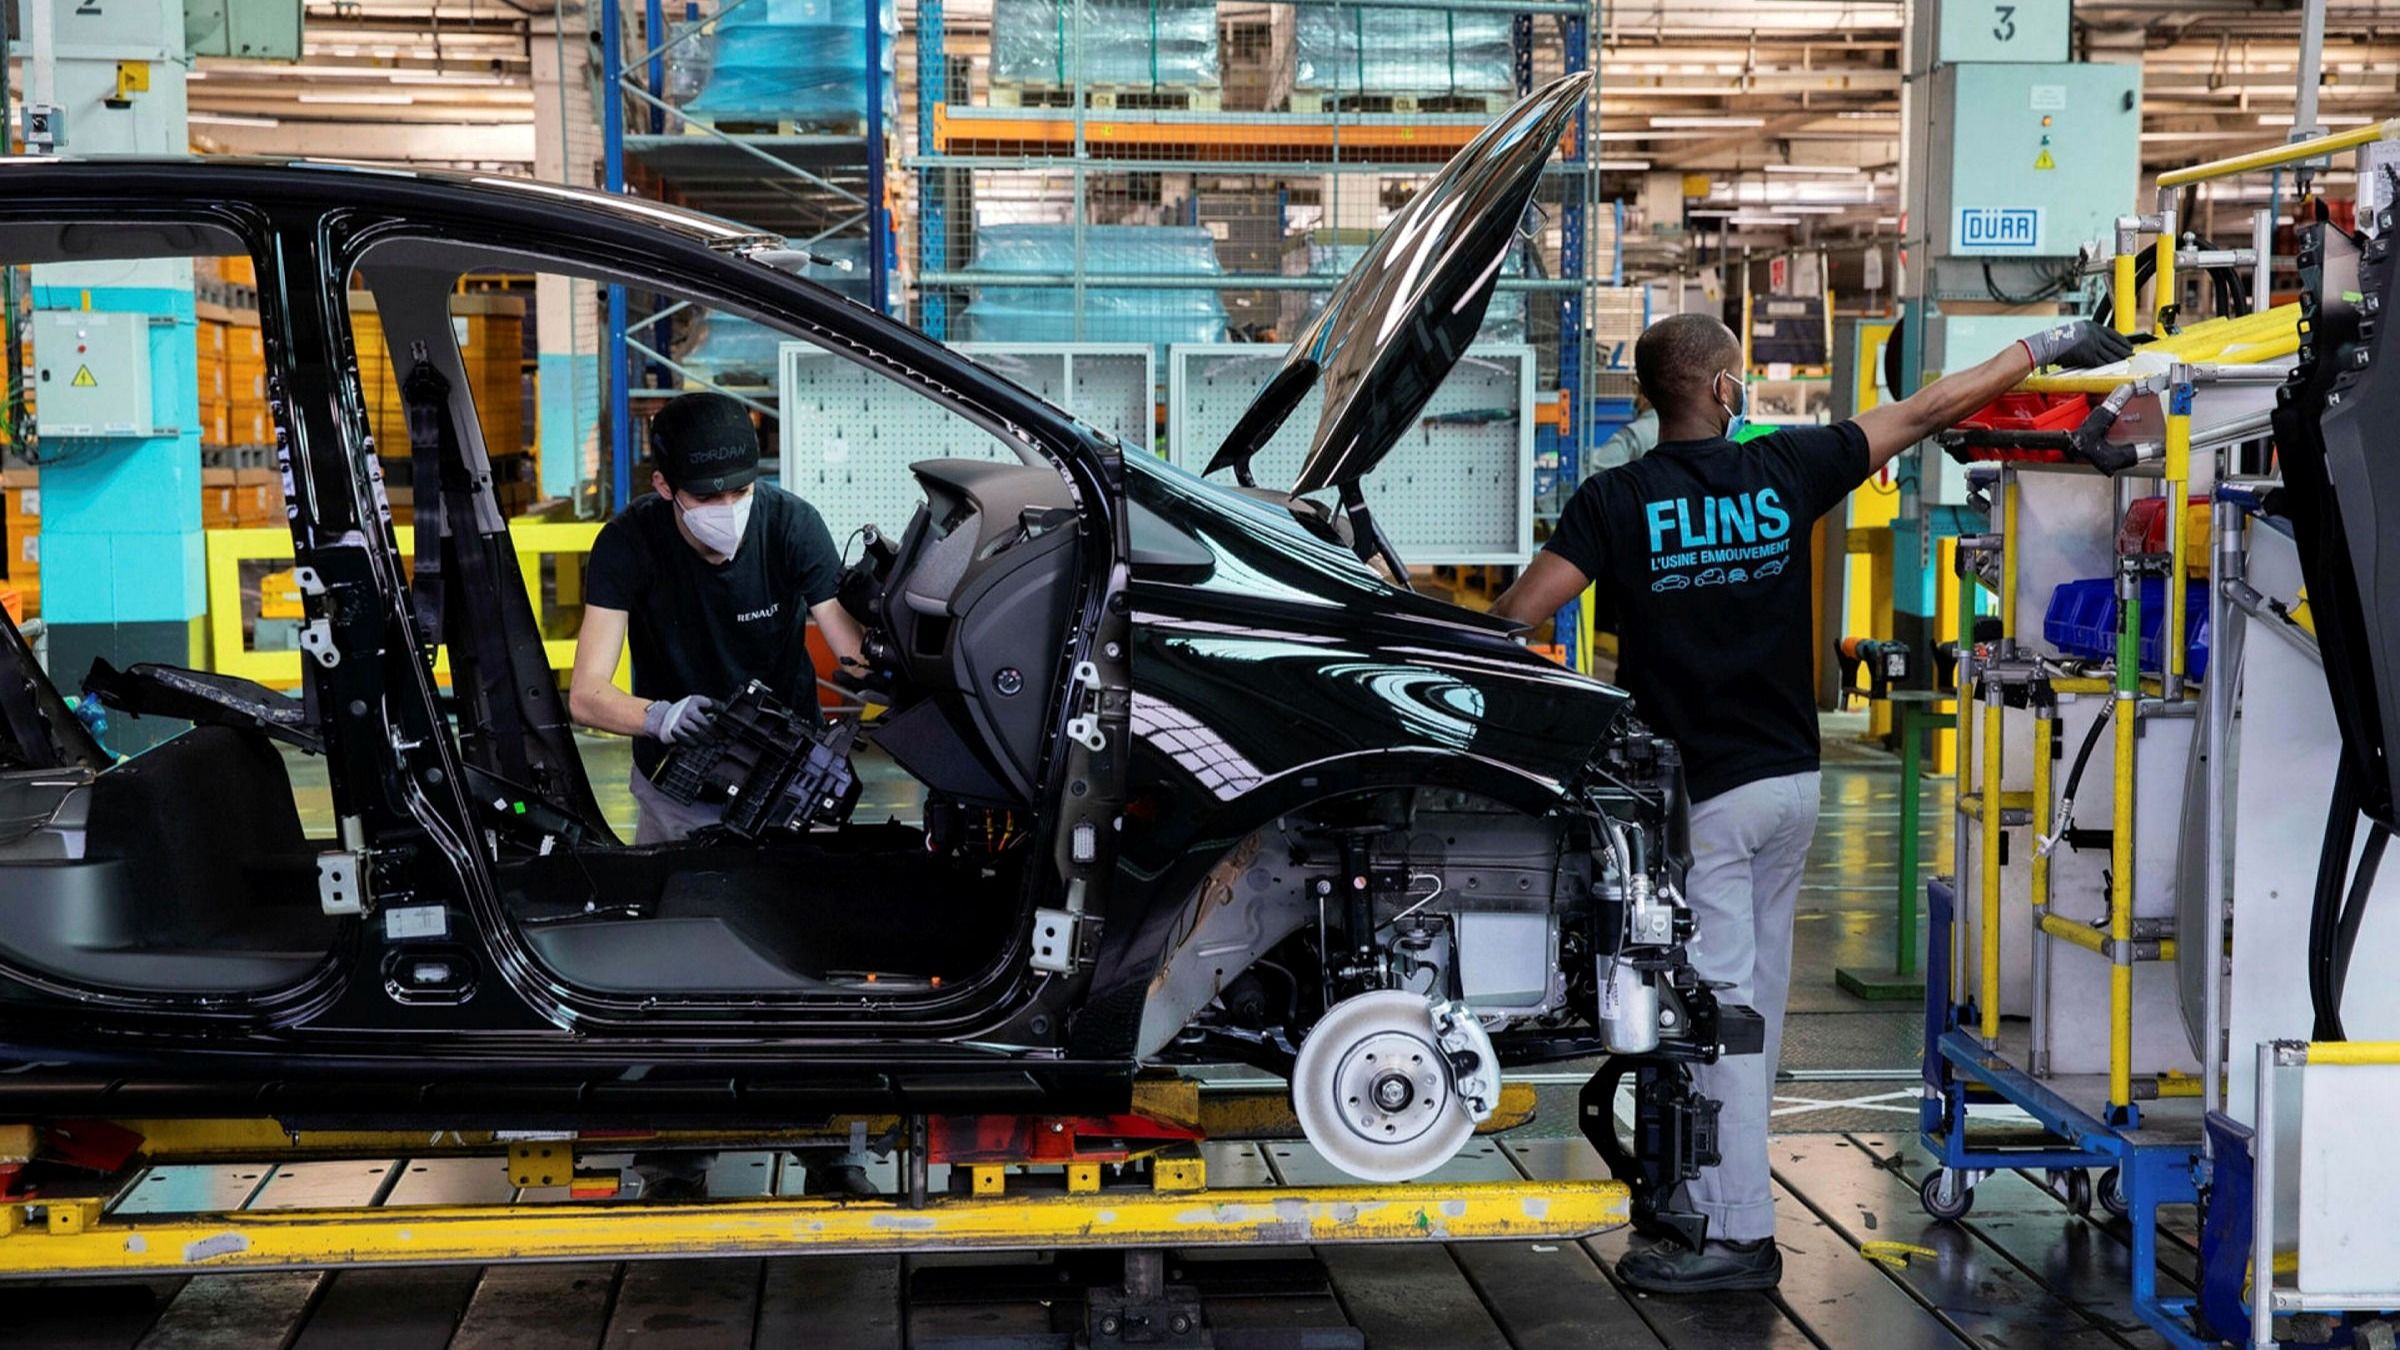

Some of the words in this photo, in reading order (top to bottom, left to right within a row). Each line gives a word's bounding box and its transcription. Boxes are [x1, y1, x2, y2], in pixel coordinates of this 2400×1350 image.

[1993, 6, 2015, 41] 3
[1646, 487, 1791, 552] FLINS
[1651, 552, 1698, 571] L'USINE
